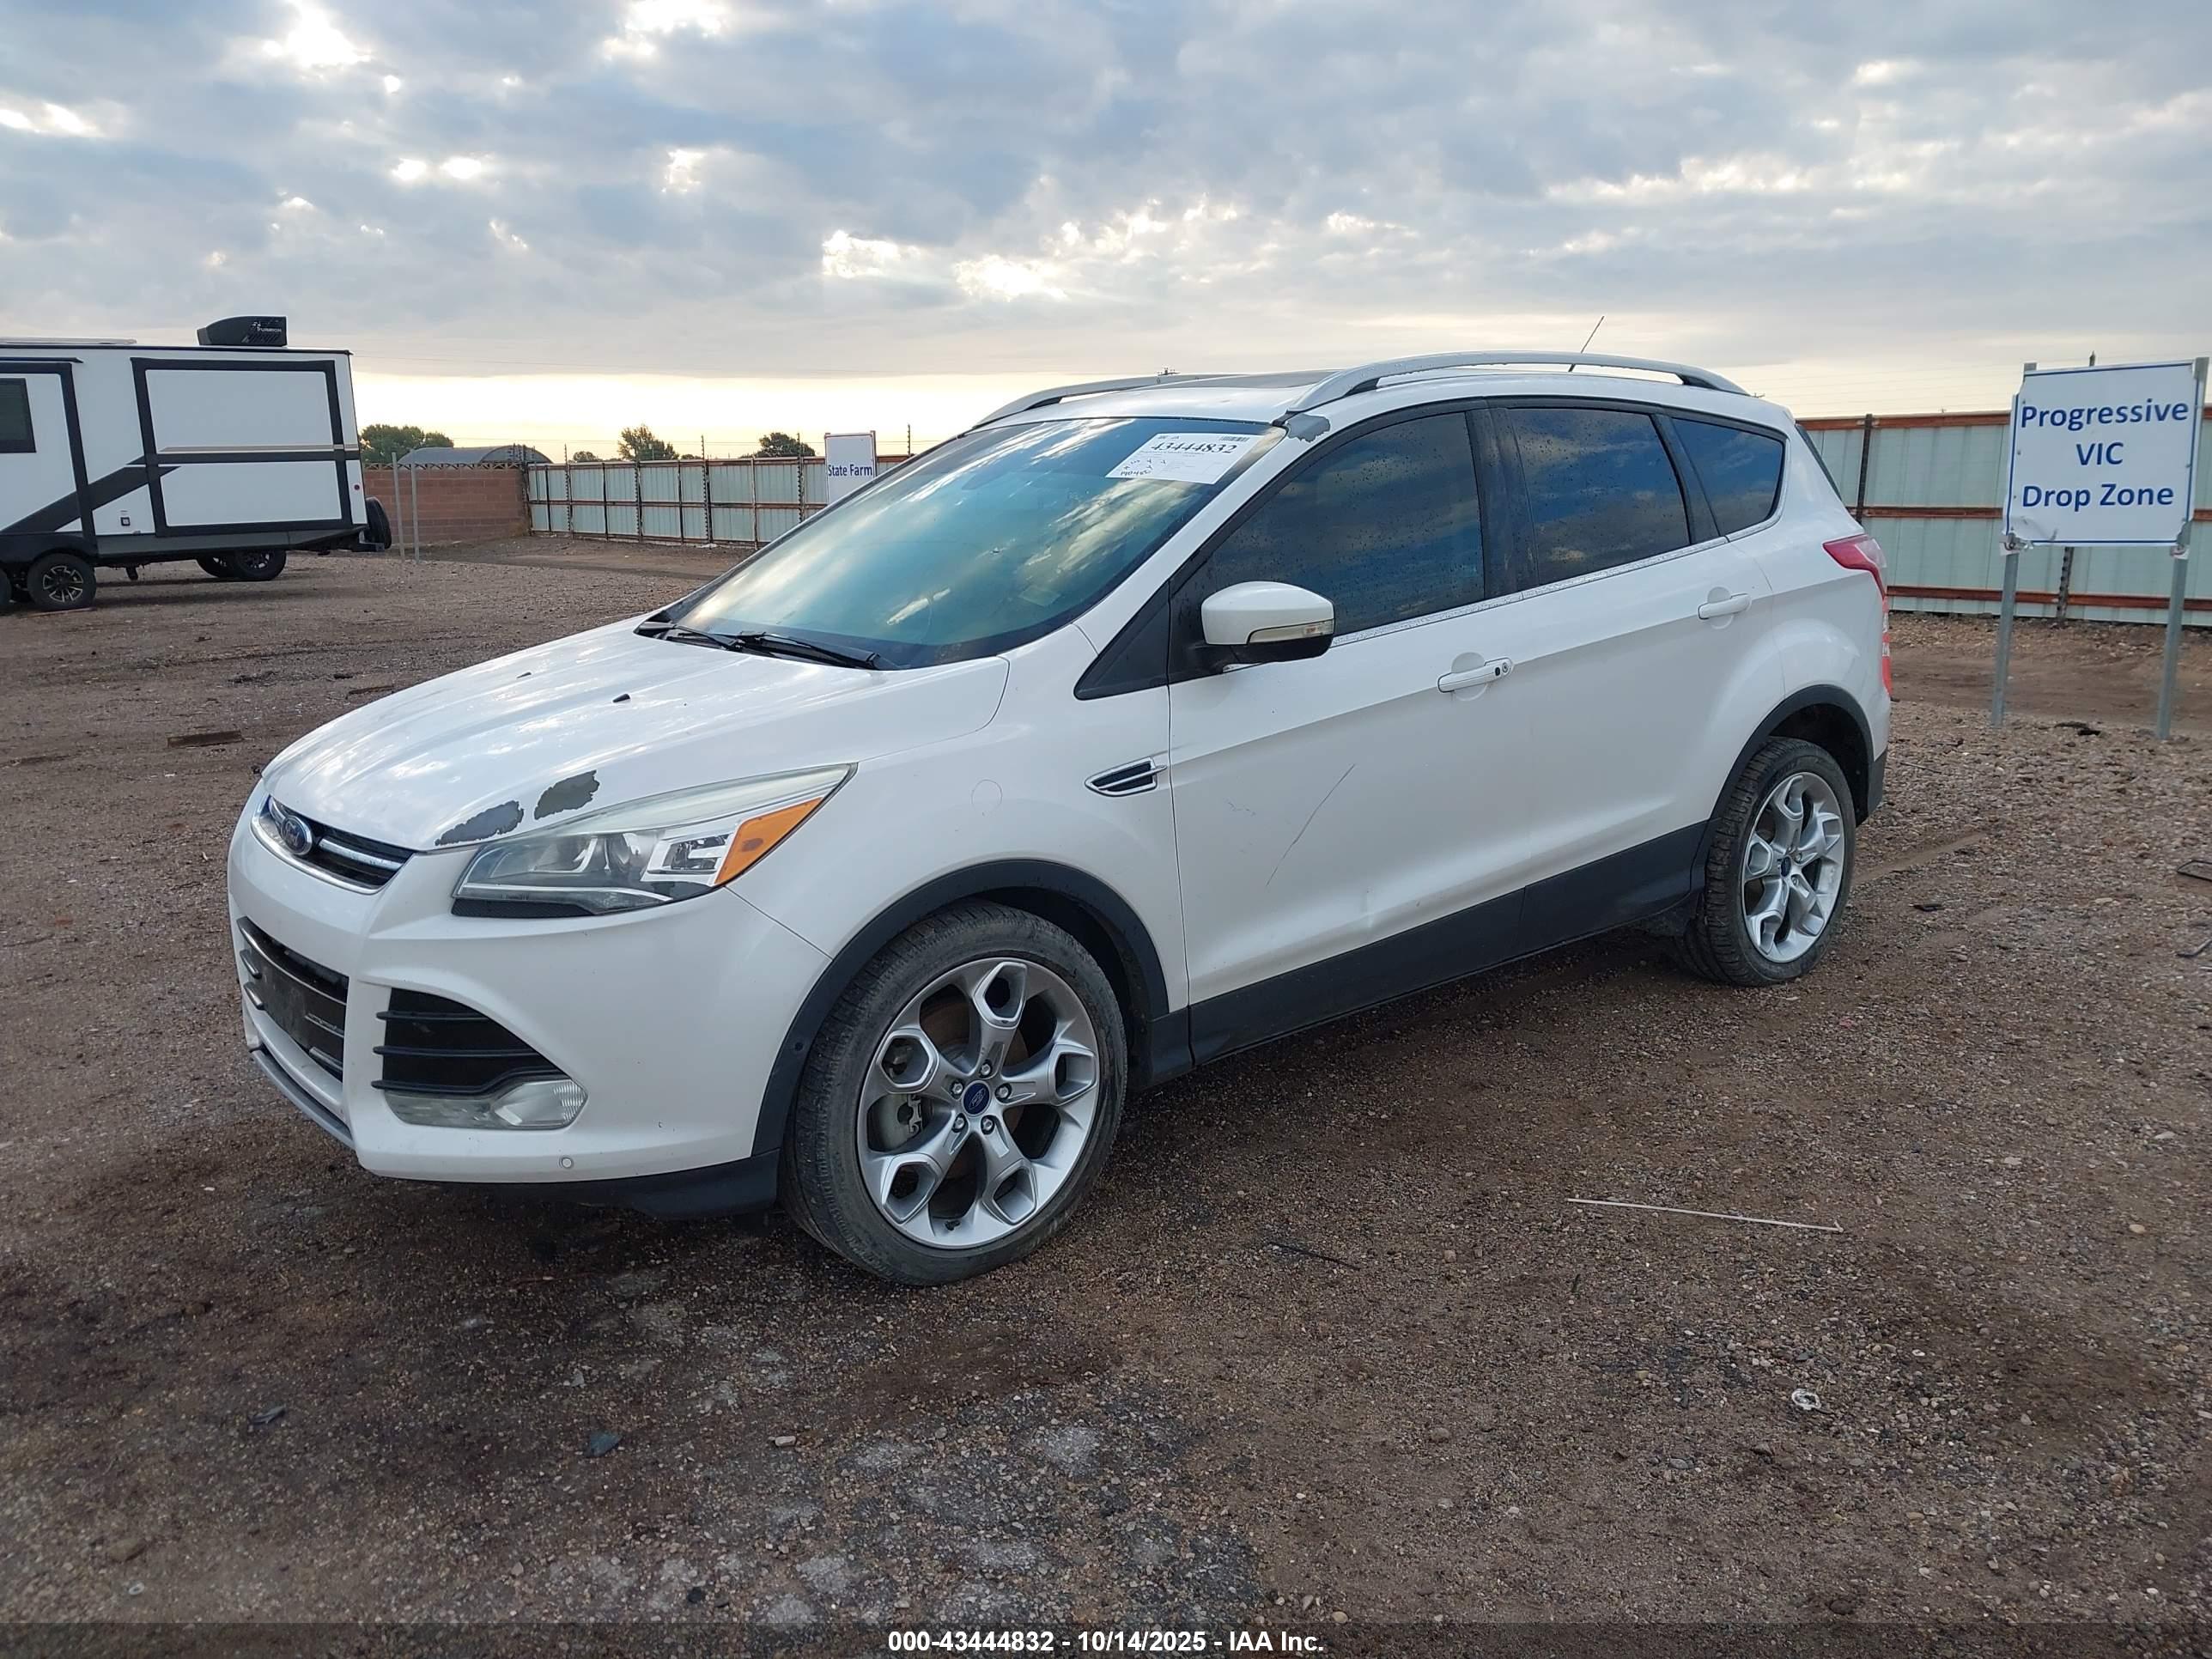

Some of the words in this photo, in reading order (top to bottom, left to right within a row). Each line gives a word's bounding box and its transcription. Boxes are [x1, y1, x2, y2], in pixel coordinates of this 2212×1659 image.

[2021, 398, 2189, 431] Progressive
[1151, 441, 1238, 454] 43444832
[2075, 441, 2124, 466] VIC
[828, 464, 848, 477] State
[849, 464, 873, 477] Farm
[2022, 485, 2091, 513] Drop
[2100, 483, 2174, 507] Zone
